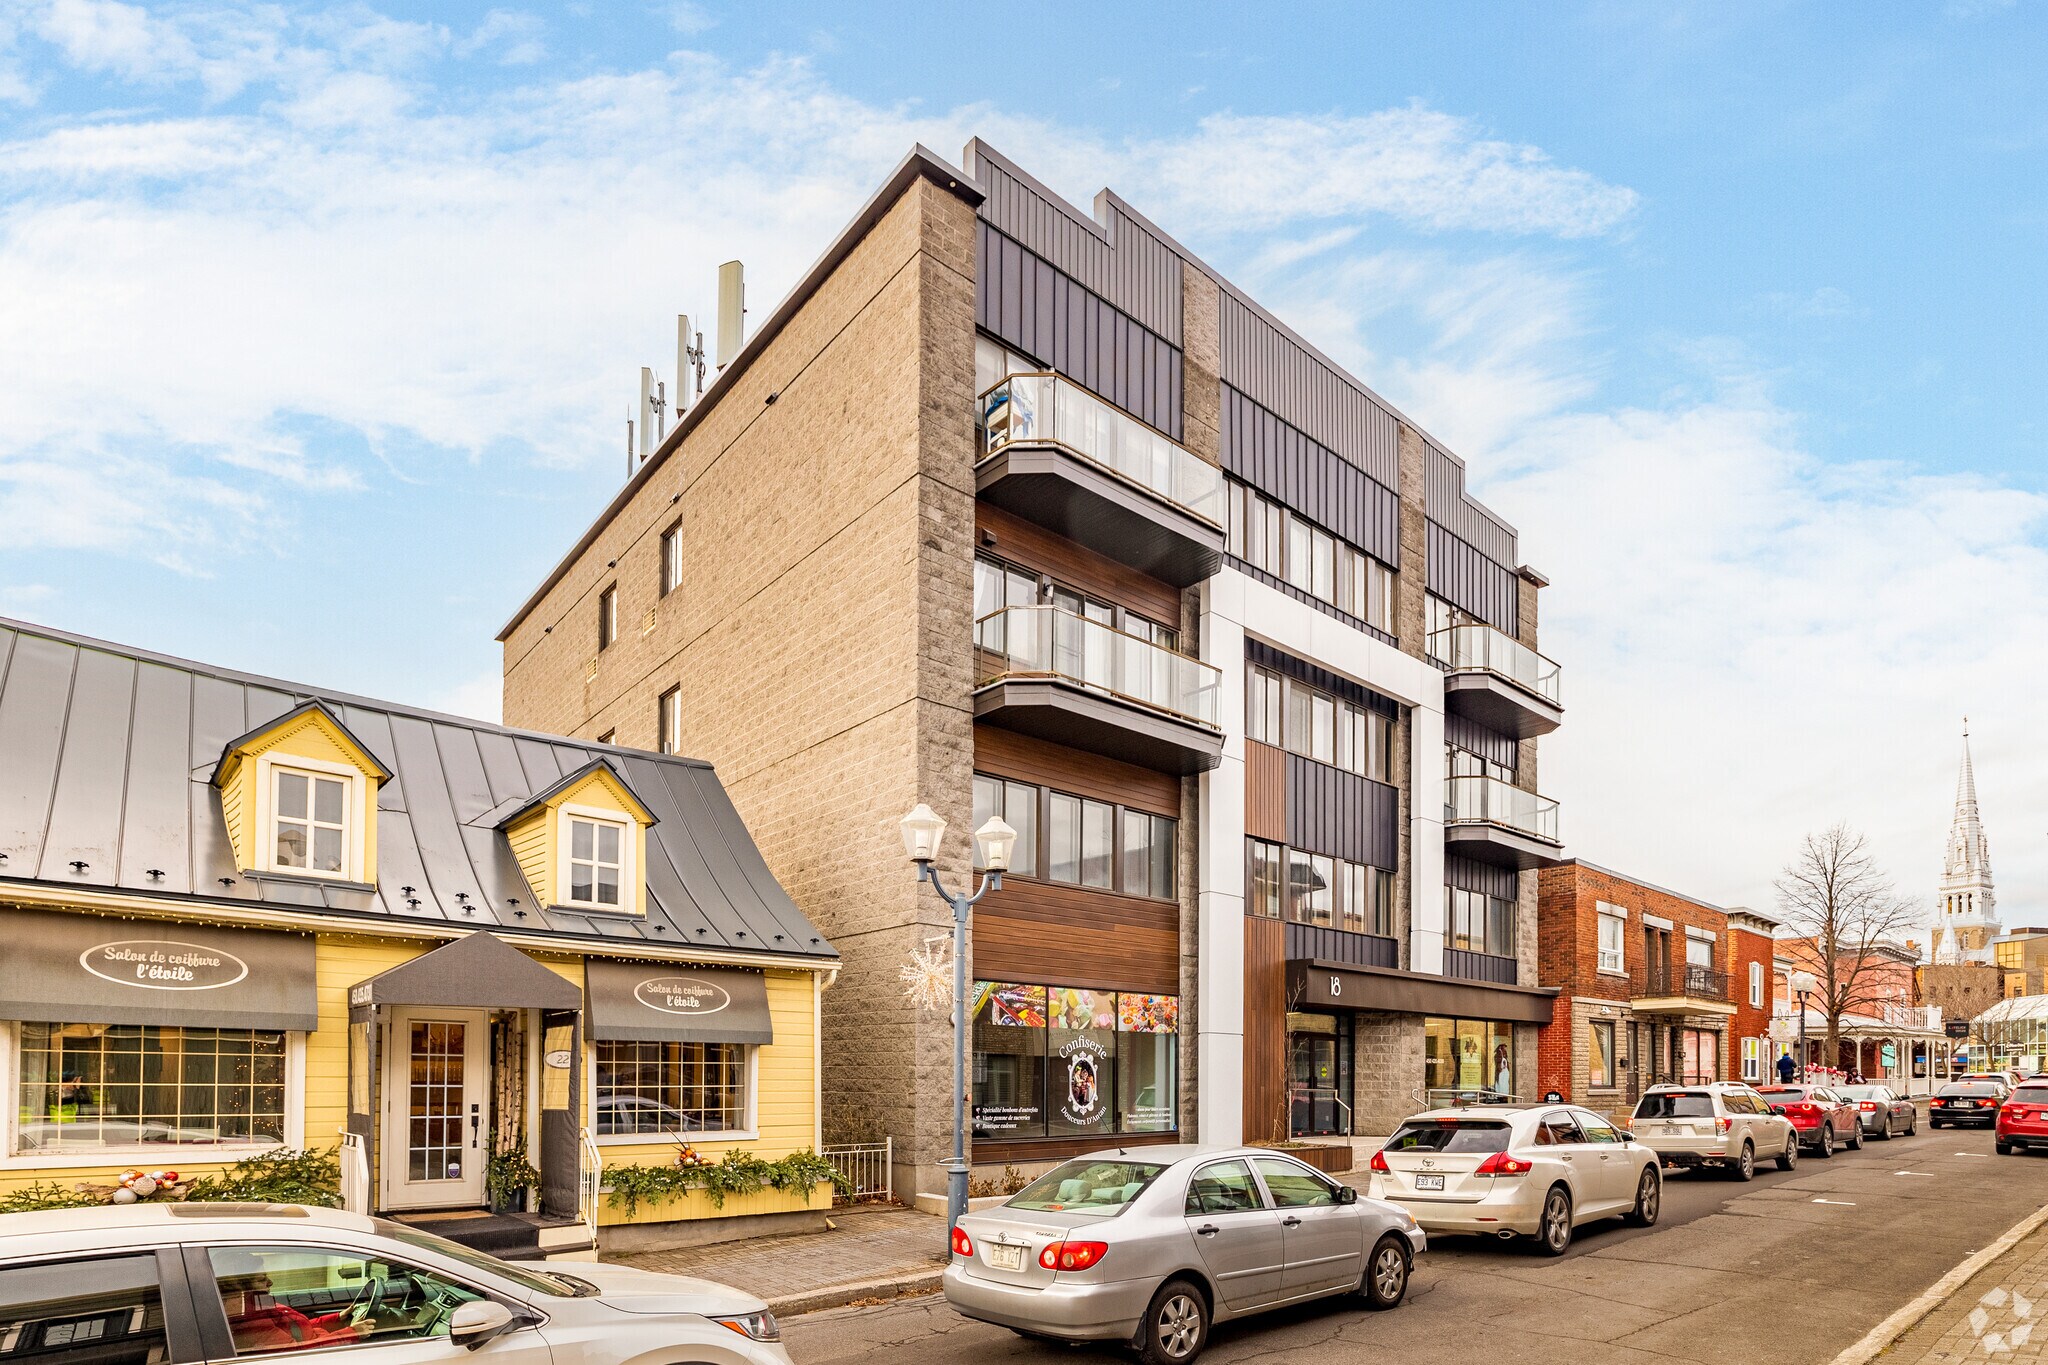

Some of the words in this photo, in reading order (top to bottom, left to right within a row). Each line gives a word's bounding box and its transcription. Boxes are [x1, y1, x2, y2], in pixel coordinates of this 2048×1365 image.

[104, 946, 147, 962] Salon
[149, 950, 166, 963] de
[168, 952, 221, 967] coiffure
[136, 963, 194, 981] l'étoile
[646, 983, 671, 994] Salon
[672, 984, 683, 995] de
[683, 985, 714, 997] coiffure
[1330, 976, 1341, 996] 18
[666, 995, 701, 1008] l'étoile
[1058, 1034, 1107, 1060] Confiserie
[557, 1054, 570, 1065] 22
[1060, 1106, 1087, 1126] Douceurs
[1086, 1105, 1107, 1125] D'Antan
